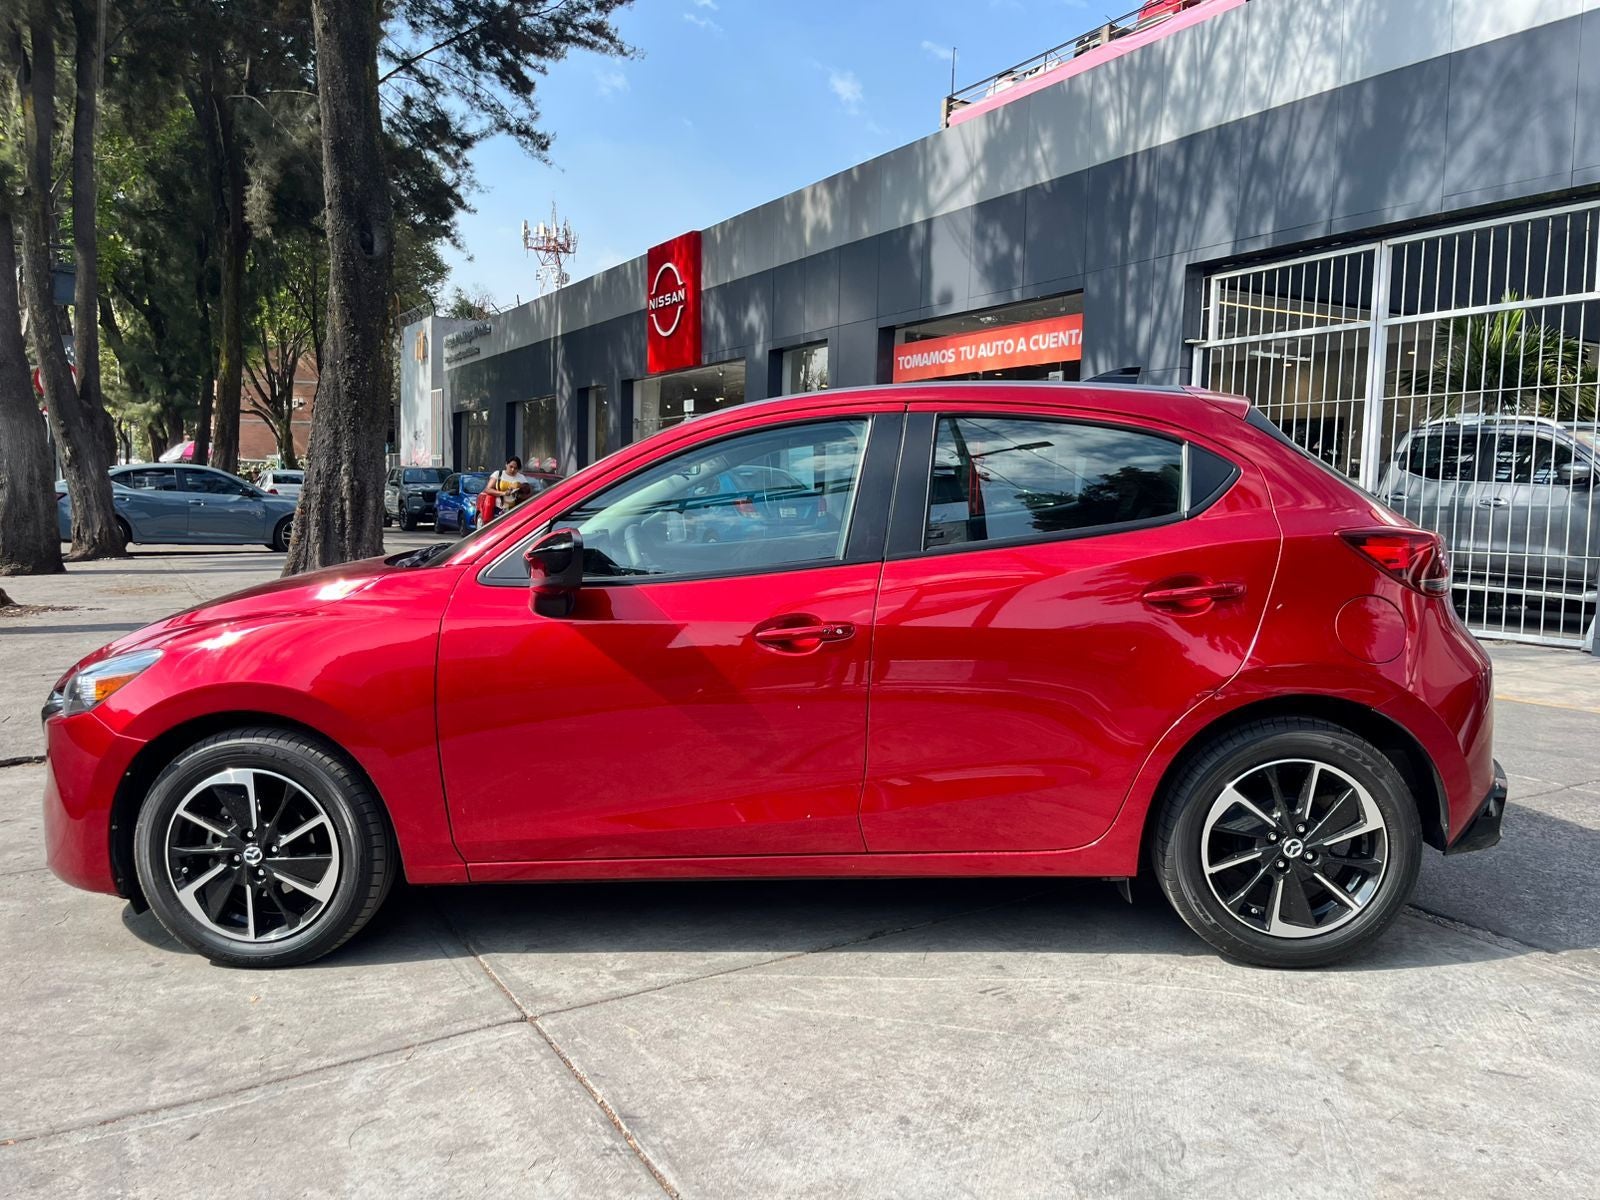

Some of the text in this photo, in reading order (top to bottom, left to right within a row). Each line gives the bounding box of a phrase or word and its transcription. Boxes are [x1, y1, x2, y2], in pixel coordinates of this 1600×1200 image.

[649, 288, 685, 310] NISSAN
[898, 348, 955, 370] TOMAMOS
[959, 344, 976, 361] TU
[977, 338, 1015, 359] AUTO
[1016, 336, 1027, 353] A
